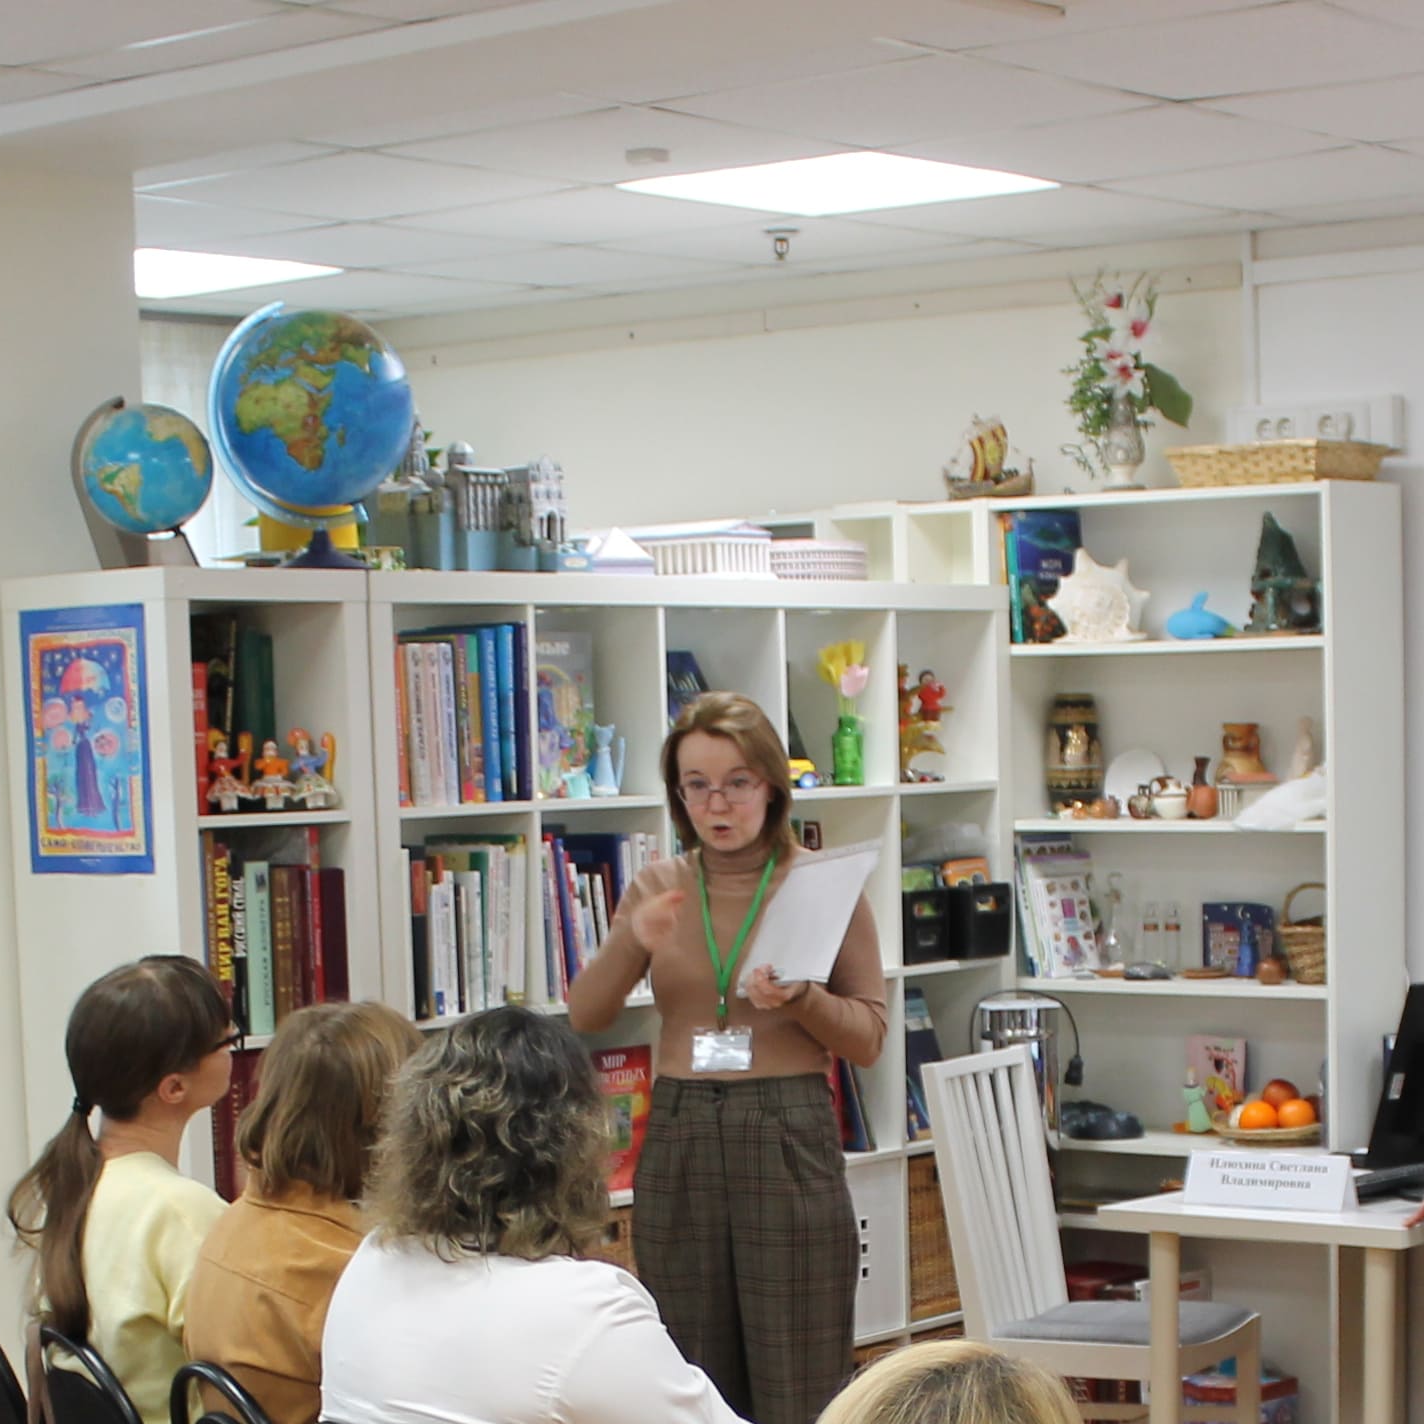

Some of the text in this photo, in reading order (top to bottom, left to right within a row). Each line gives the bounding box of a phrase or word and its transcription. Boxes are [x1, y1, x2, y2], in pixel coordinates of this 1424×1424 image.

[214, 857, 233, 981] МИР ВАН ГОГА
[1209, 1157, 1329, 1174] Илюхина Светлана
[1221, 1174, 1312, 1190] Владимировна
